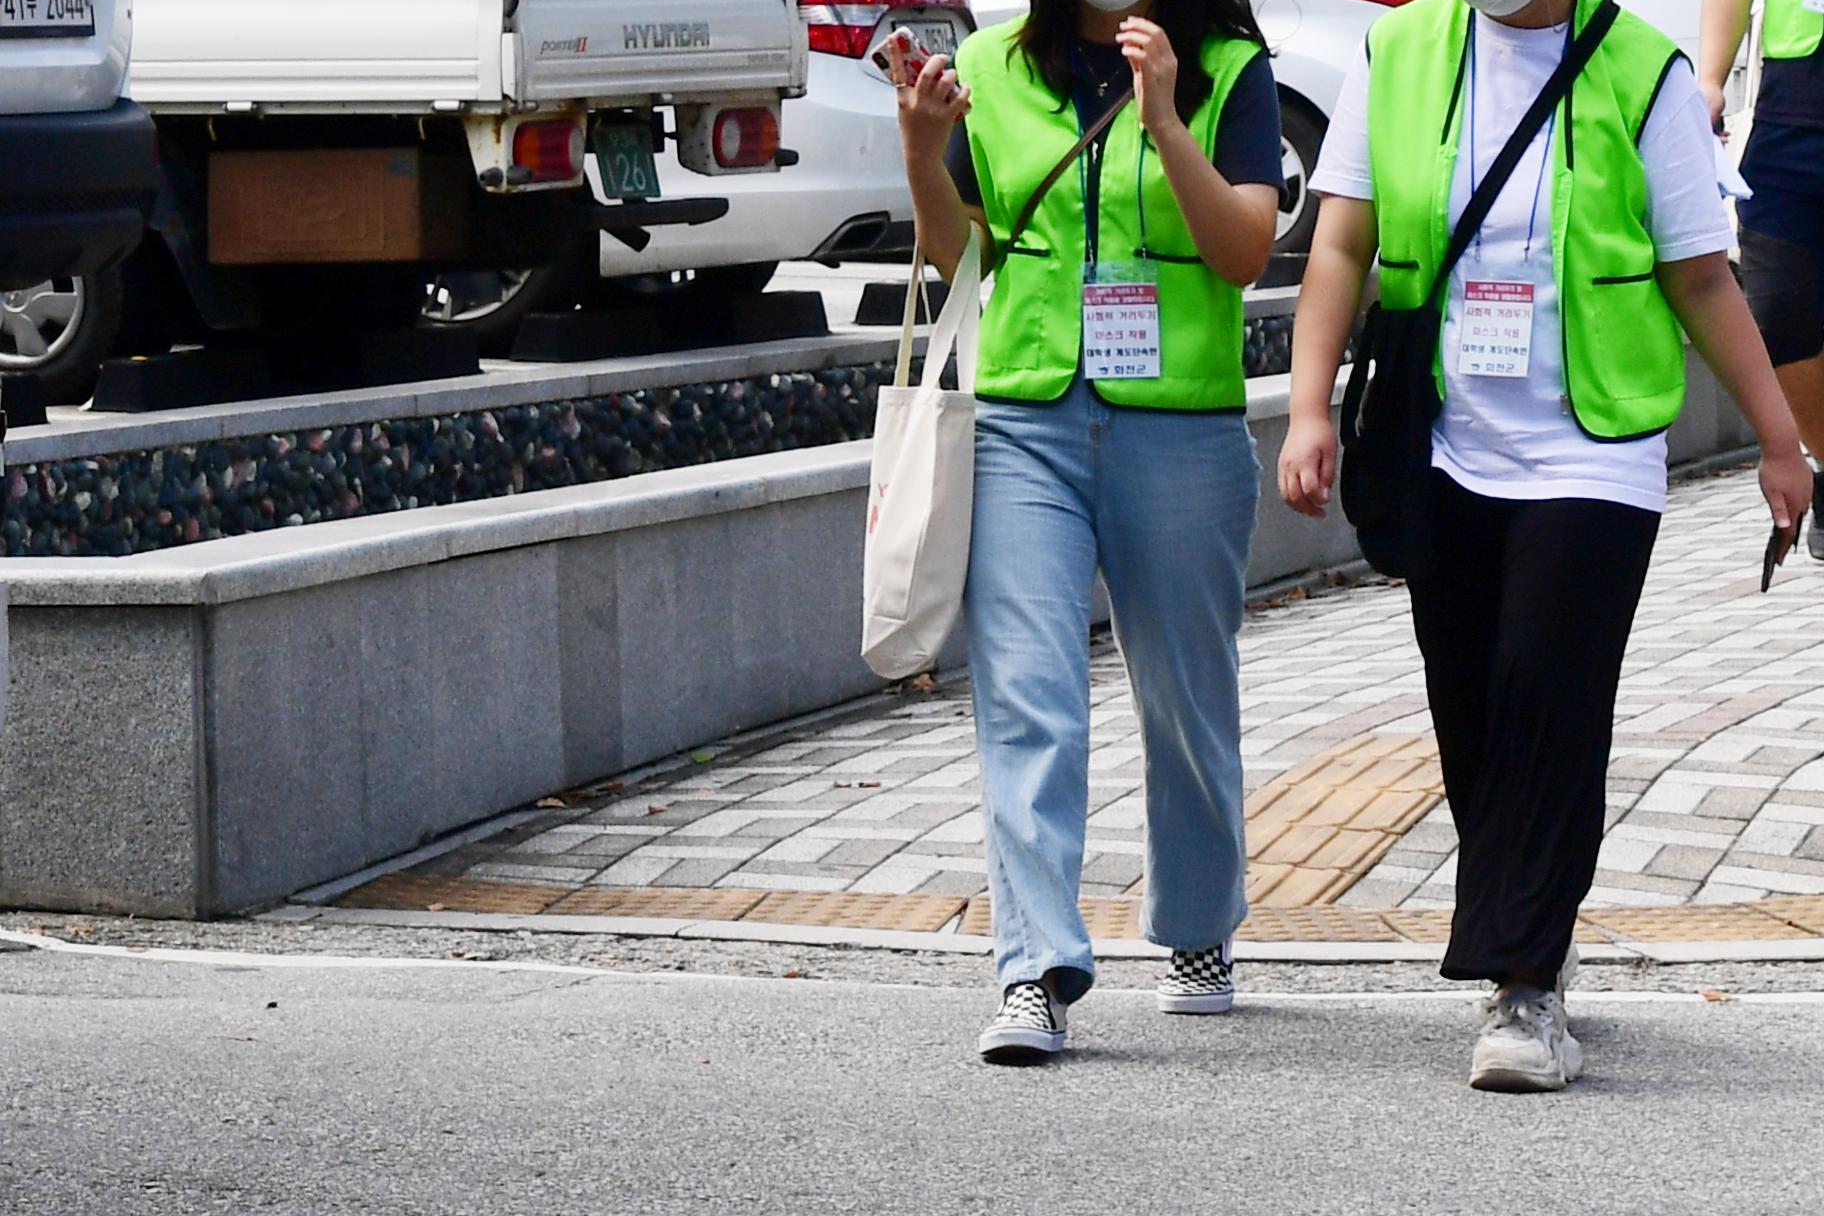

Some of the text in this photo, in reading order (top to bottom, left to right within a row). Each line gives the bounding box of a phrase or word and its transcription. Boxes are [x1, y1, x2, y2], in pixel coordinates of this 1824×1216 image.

[623, 22, 710, 49] HYUNDAI
[1119, 309, 1156, 321] 거리두기
[1466, 307, 1531, 319] 사회적 거리두기
[1095, 329, 1147, 340] 마스크 착용
[1472, 326, 1521, 339] 마스크 착용
[1086, 347, 1111, 357] 대학생
[1462, 344, 1485, 353] 대학생
[1114, 364, 1147, 375] 화천군
[1486, 363, 1515, 374] 화천군
